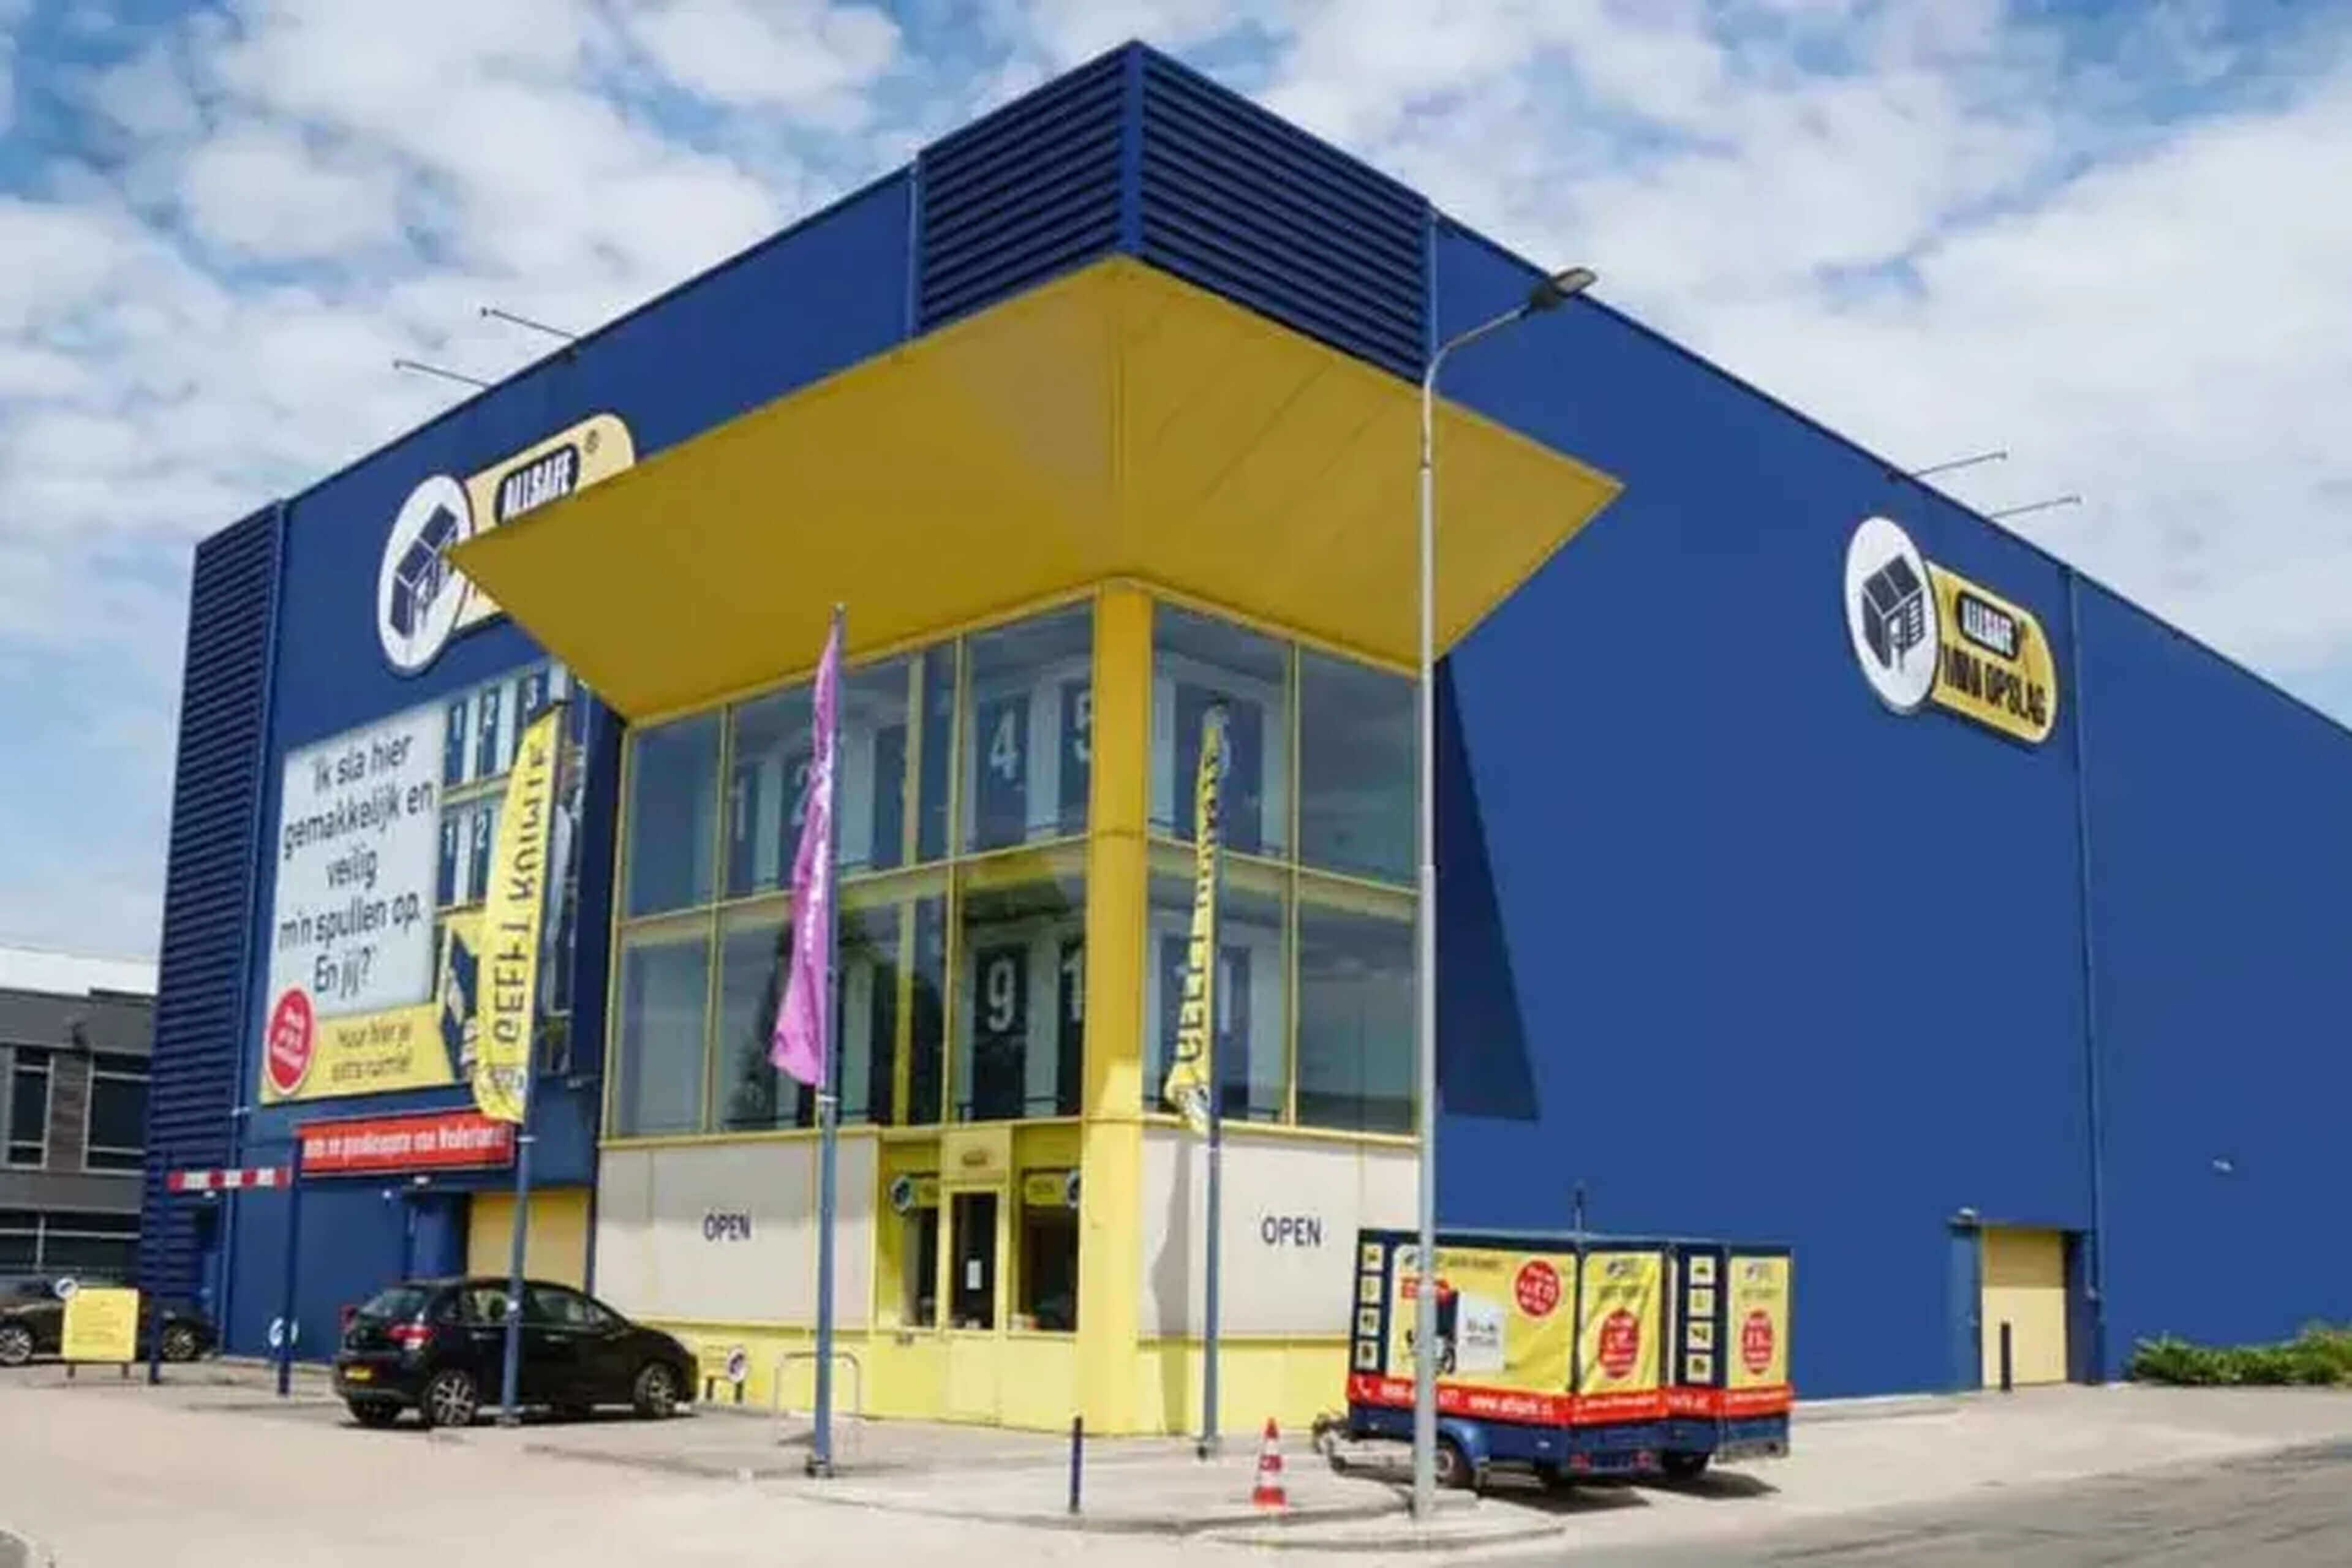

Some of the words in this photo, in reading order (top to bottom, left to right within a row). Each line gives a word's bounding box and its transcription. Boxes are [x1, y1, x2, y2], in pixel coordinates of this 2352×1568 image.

[337, 744, 366, 786] sla
[369, 734, 413, 777] hier
[990, 709, 1017, 780] 4
[284, 782, 401, 861] gemakkelijk
[407, 780, 434, 816] en
[326, 843, 378, 890] veilig
[315, 896, 388, 948] spullen
[315, 955, 339, 992] En
[987, 957, 1015, 1033] 9
[704, 1210, 752, 1242] OPEN
[1261, 1216, 1322, 1246] OPEN
